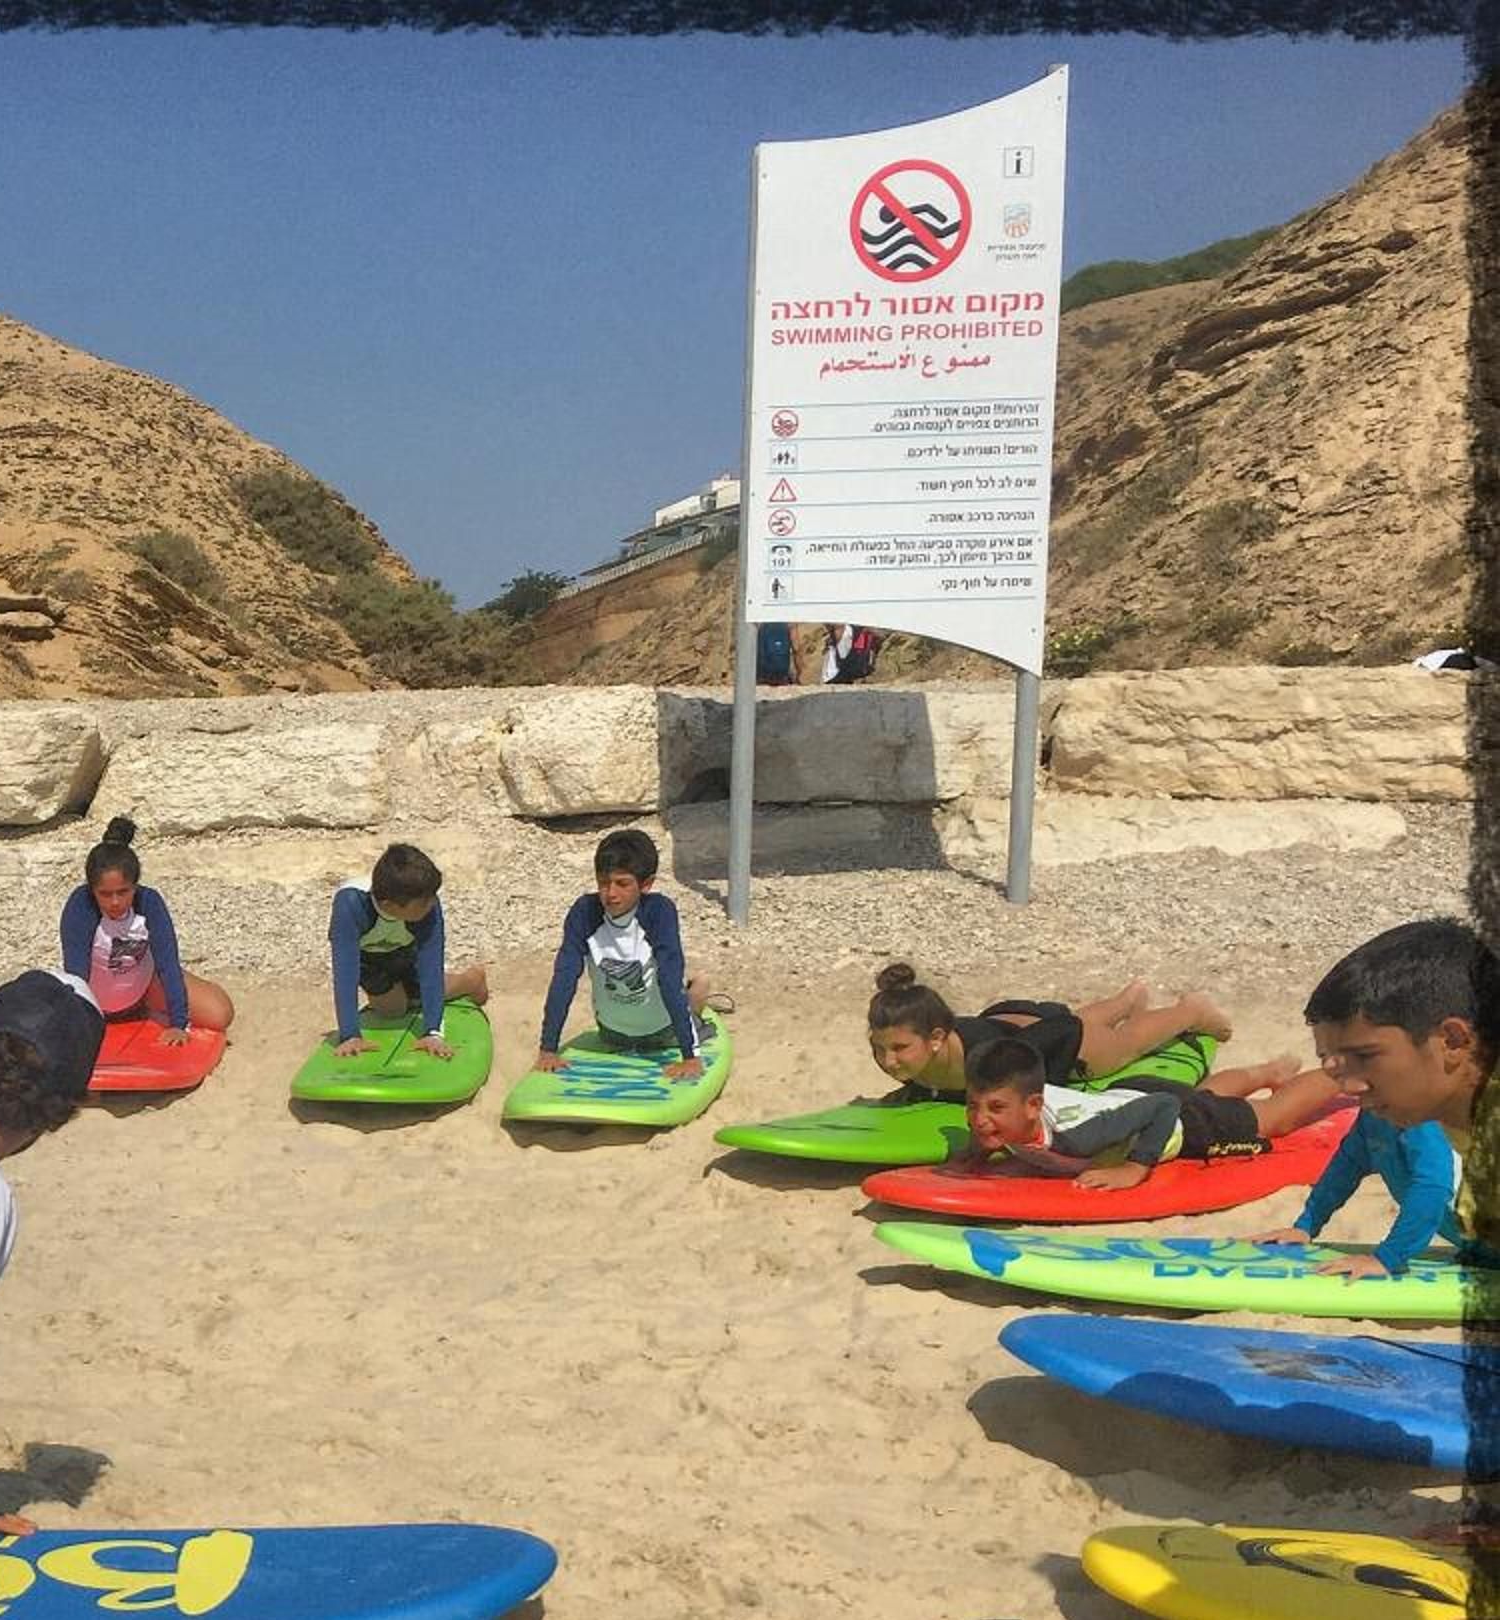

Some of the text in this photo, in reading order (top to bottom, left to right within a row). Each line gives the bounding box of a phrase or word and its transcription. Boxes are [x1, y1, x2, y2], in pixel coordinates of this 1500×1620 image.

[771, 291, 1045, 320] מקום אסור לרחצה
[771, 319, 1044, 345] SWIMMING PROHIBITED
[933, 406, 959, 417] אסור
[962, 405, 991, 418] מקום
[945, 444, 960, 457] על
[950, 478, 973, 492] חפץ
[975, 476, 996, 489] לכל
[998, 476, 1012, 488] לב
[1014, 477, 1037, 488] שים
[1016, 537, 1033, 547] אם
[1016, 550, 1033, 560] אם
[960, 577, 981, 590] חוף
[983, 575, 998, 587] על
